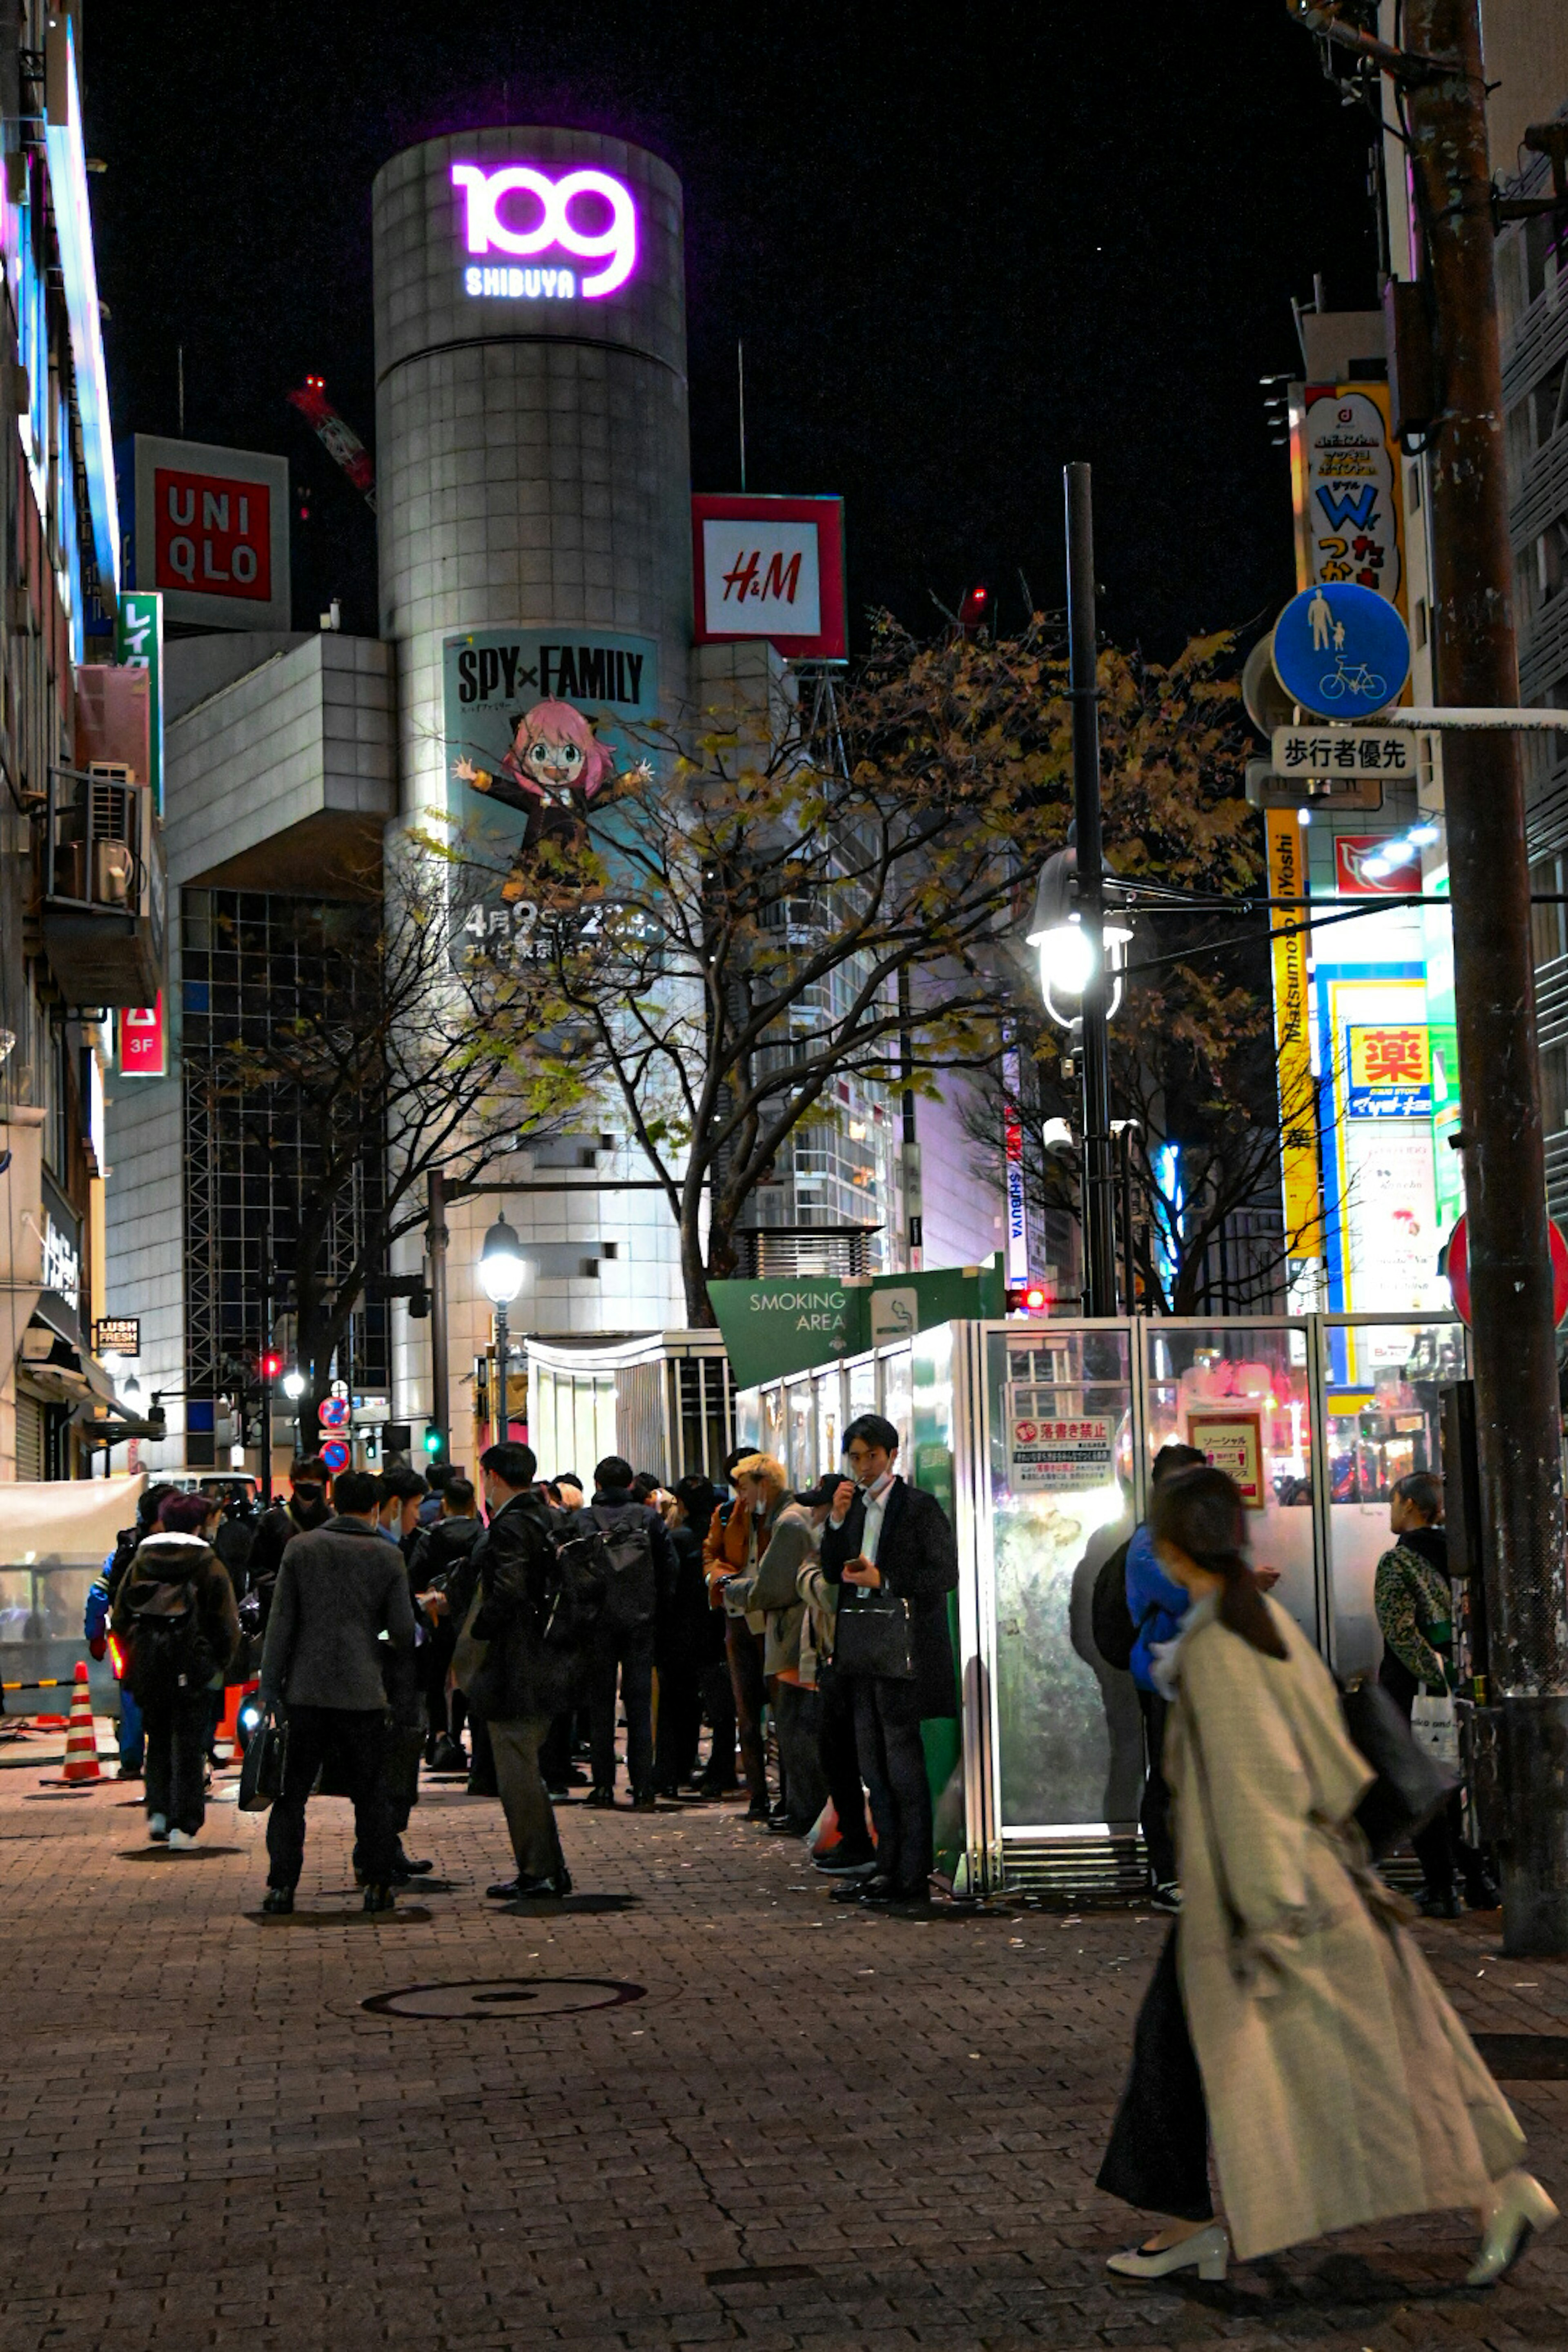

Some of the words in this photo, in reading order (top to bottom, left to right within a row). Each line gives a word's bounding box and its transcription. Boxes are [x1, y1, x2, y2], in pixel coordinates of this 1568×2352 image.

[451, 165, 636, 298] 109
[465, 266, 576, 299] SHIBUYA
[168, 485, 250, 536] UNI
[168, 534, 259, 586] QLO
[722, 551, 802, 604] H&M
[1285, 739, 1406, 767] 歩行者優先
[130, 1038, 153, 1053] 3F
[1363, 1030, 1423, 1082] 薬
[1009, 1173, 1022, 1239] SHIBUYA
[750, 1291, 846, 1312] SMOKING
[99, 1321, 138, 1332] LUSH
[796, 1313, 846, 1331] AREA
[99, 1332, 137, 1342] FRESH
[1040, 1422, 1107, 1439] 落書き禁止
[1203, 1437, 1247, 1446] ソーシャル
